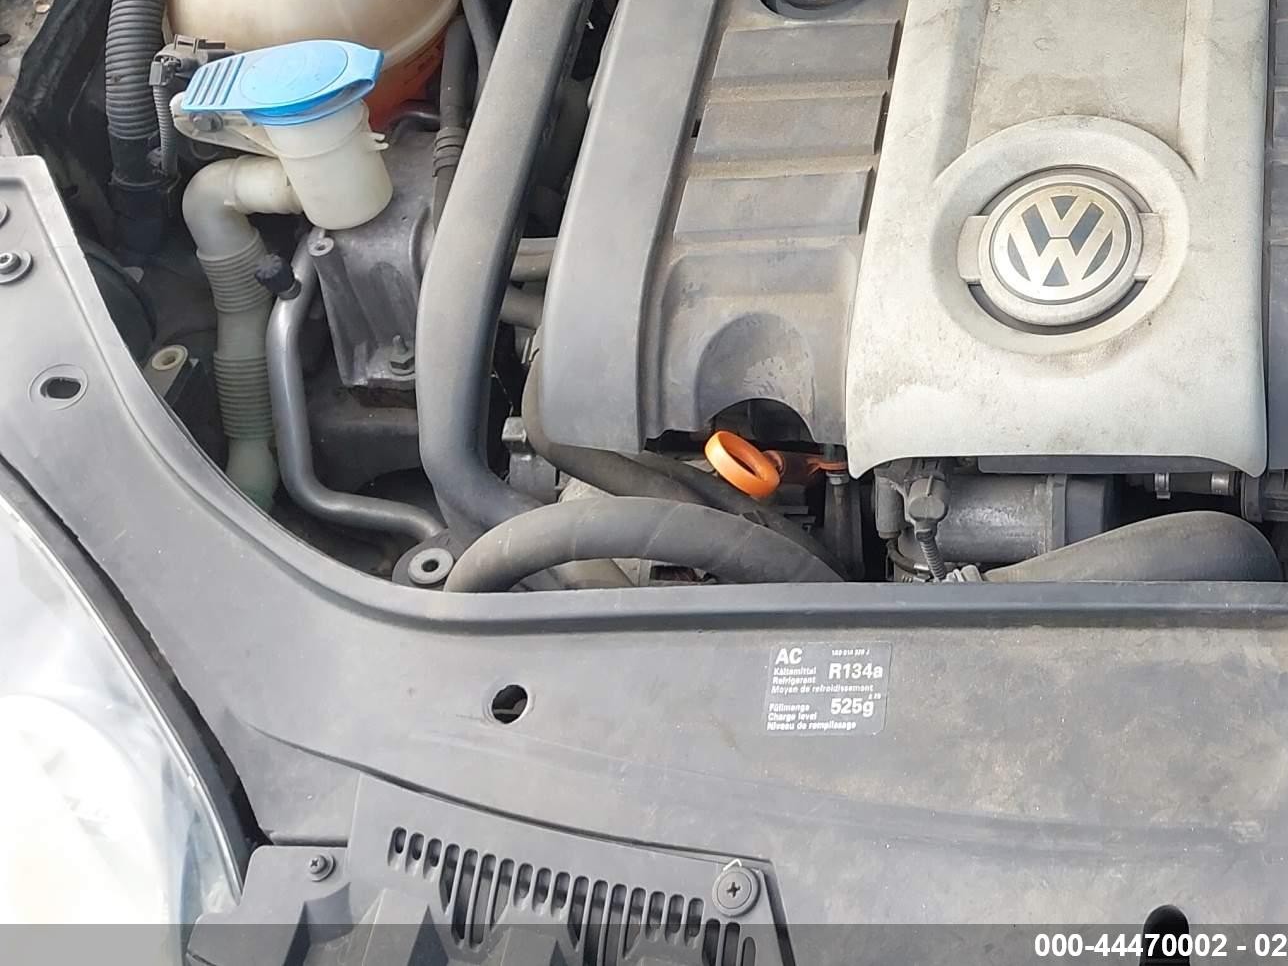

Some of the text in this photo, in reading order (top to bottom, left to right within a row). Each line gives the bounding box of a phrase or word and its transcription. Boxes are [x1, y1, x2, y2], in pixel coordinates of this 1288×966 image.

[775, 647, 803, 665] AC
[828, 662, 883, 680] R134a
[772, 676, 816, 686] Refrigerant
[771, 684, 799, 695] Moyen
[800, 684, 811, 694] de
[830, 697, 874, 718] 525g
[768, 711, 817, 722] Charge level
[767, 721, 795, 731] Niveau
